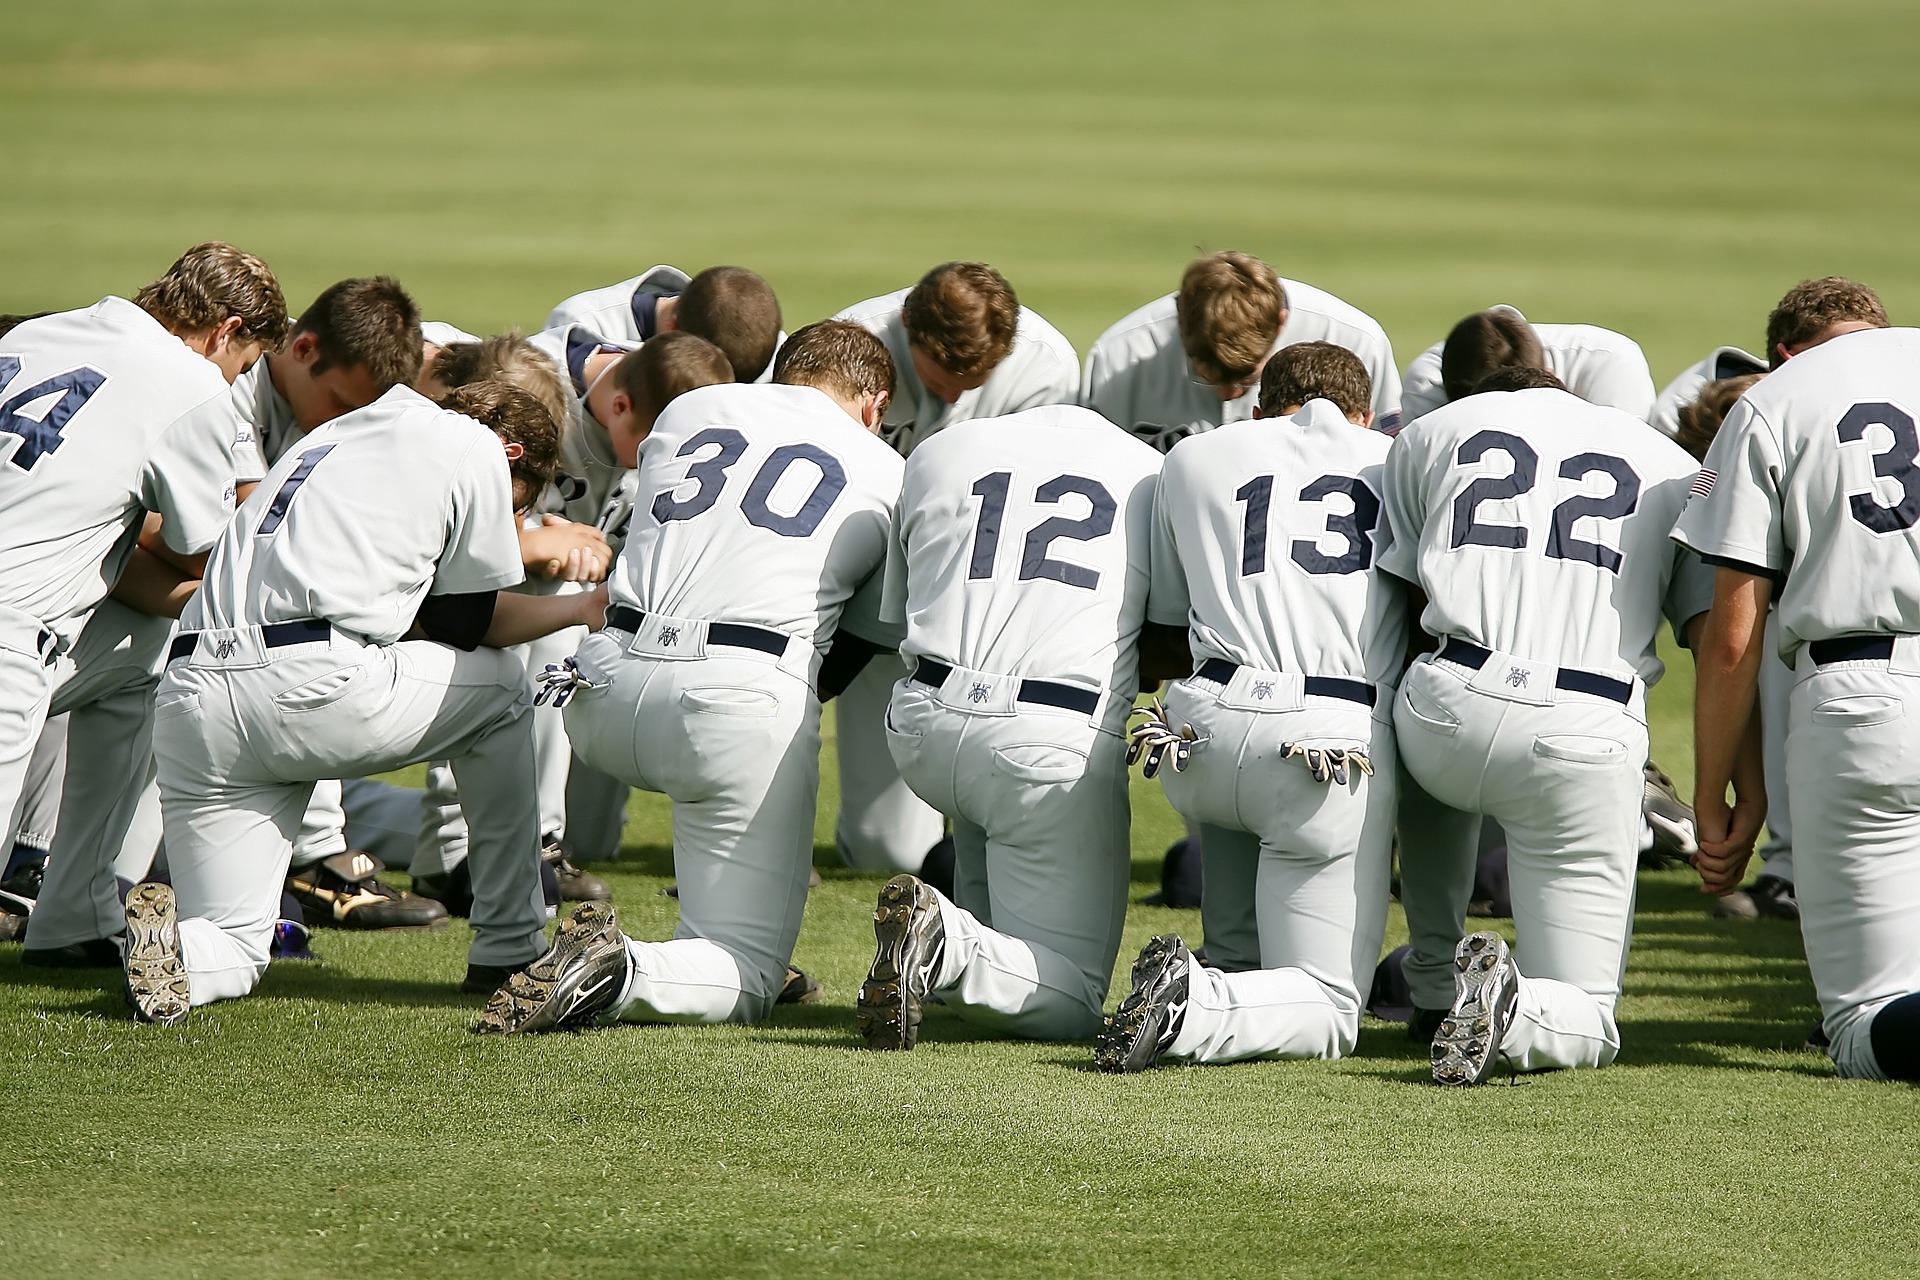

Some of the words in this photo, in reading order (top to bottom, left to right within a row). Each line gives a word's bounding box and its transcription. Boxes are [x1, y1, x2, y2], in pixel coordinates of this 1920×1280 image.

[256, 444, 338, 535] 1
[651, 428, 849, 538] 30
[967, 471, 1119, 591] 12
[1235, 474, 1381, 577] 13
[1450, 429, 1643, 576] 22
